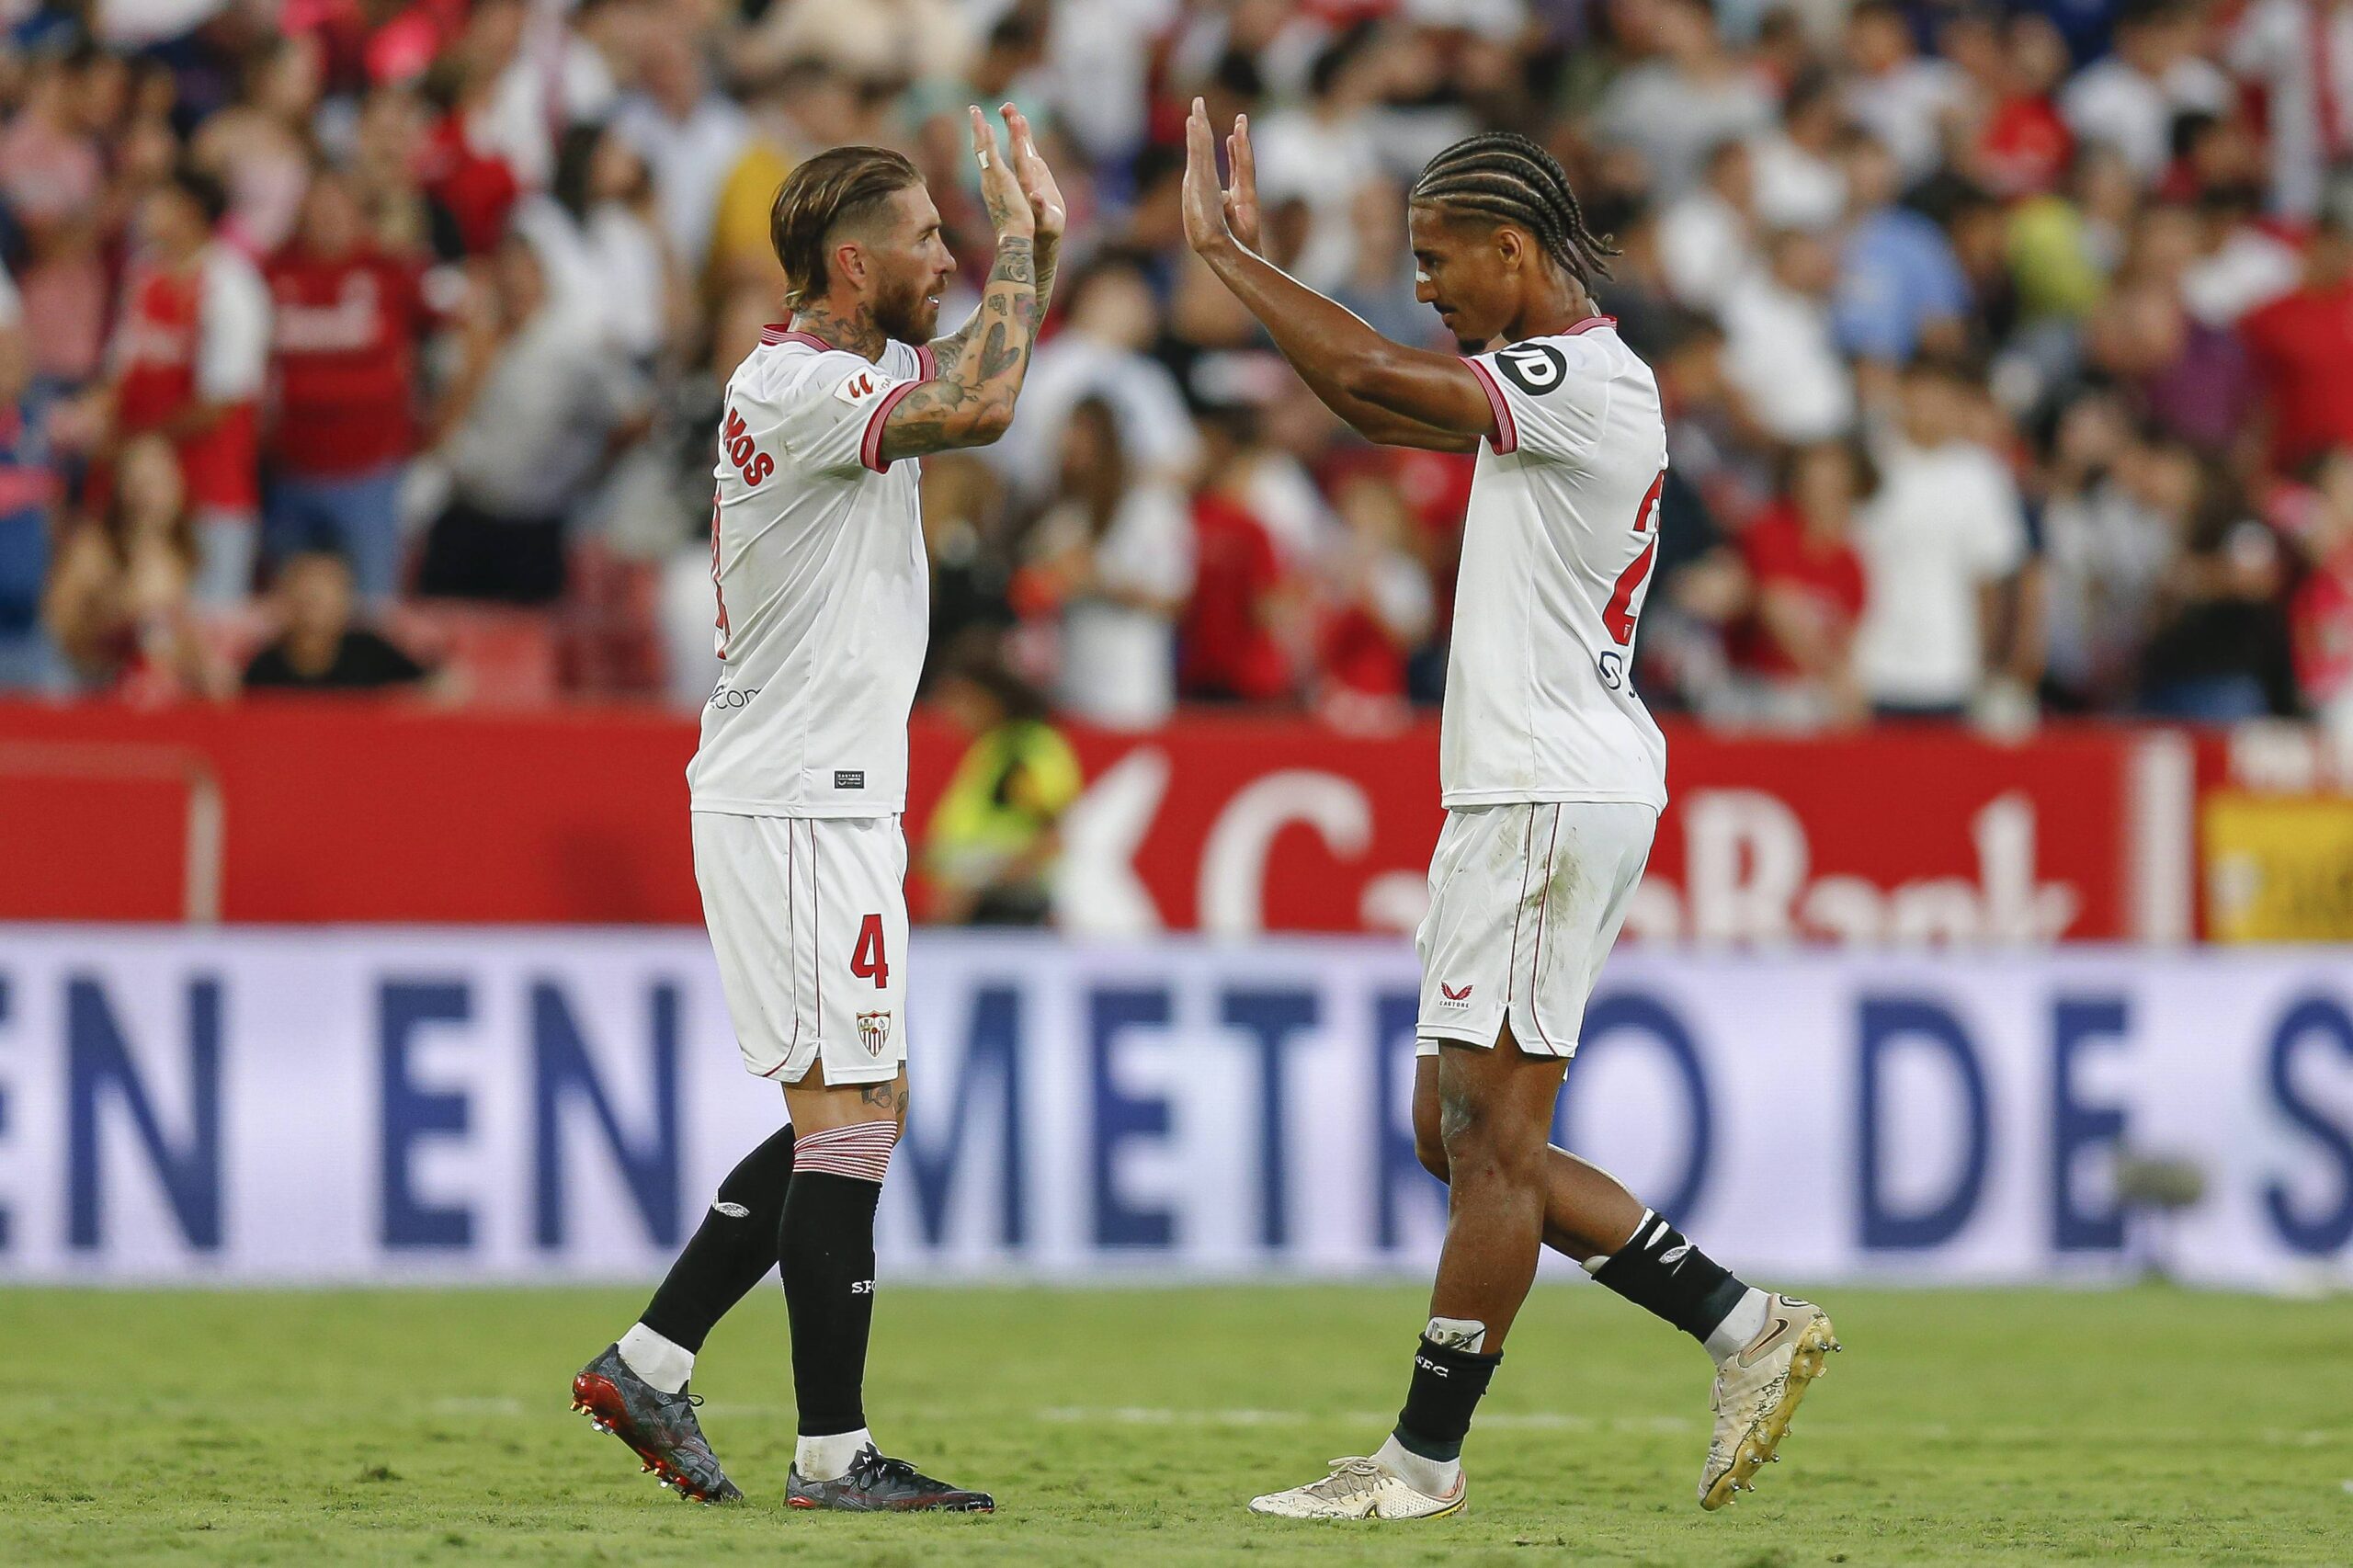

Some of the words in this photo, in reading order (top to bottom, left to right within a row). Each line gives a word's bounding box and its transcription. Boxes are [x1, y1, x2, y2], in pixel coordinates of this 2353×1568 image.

[850, 914, 889, 989] 4
[379, 980, 679, 1250] EN
[1859, 998, 2127, 1250] DE
